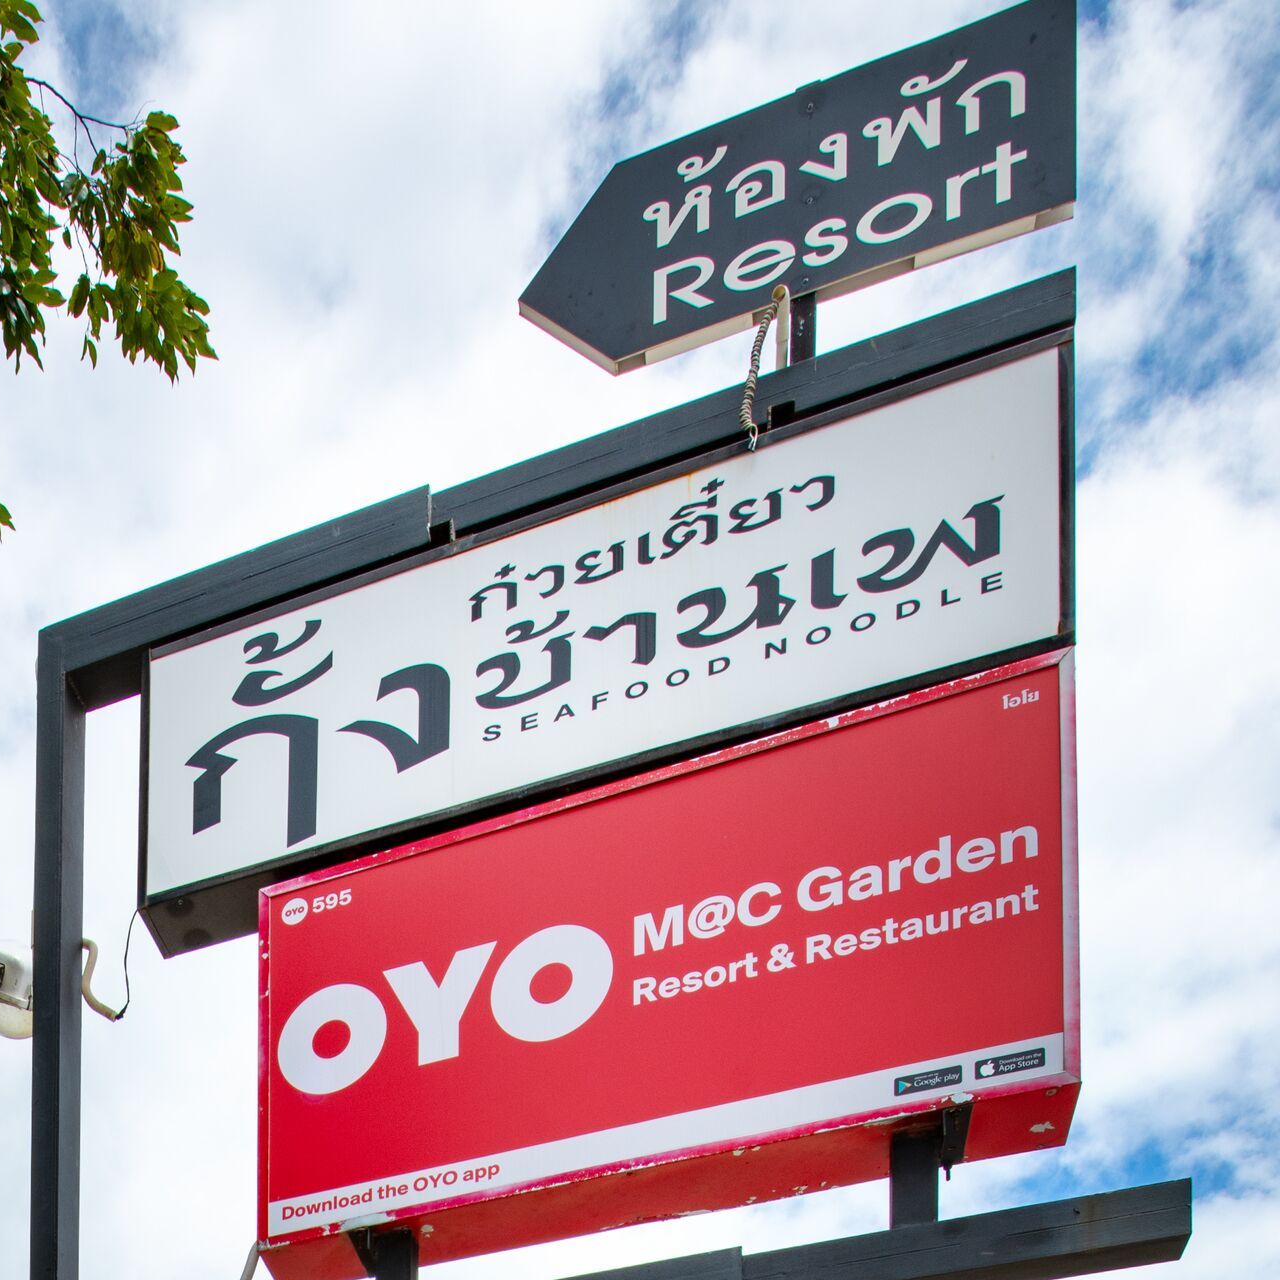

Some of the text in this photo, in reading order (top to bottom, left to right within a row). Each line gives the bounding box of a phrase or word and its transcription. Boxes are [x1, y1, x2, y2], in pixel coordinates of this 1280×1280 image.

[642, 58, 1026, 248] ห้องพัก
[652, 142, 1028, 325] Resort
[467, 475, 835, 623] ก๋วยเตี๋ยว
[481, 571, 1004, 743] SEAFOOD NOODLE
[284, 888, 352, 918] OYO 595
[632, 824, 1039, 957] M@C Garden
[632, 883, 1039, 1006] Resort & Restaurant
[277, 924, 614, 1095] OYO
[999, 1058, 1039, 1073] App Store
[913, 1075, 942, 1087] Google
[944, 1072, 960, 1083] play
[281, 1163, 500, 1220] Download the OYO app
